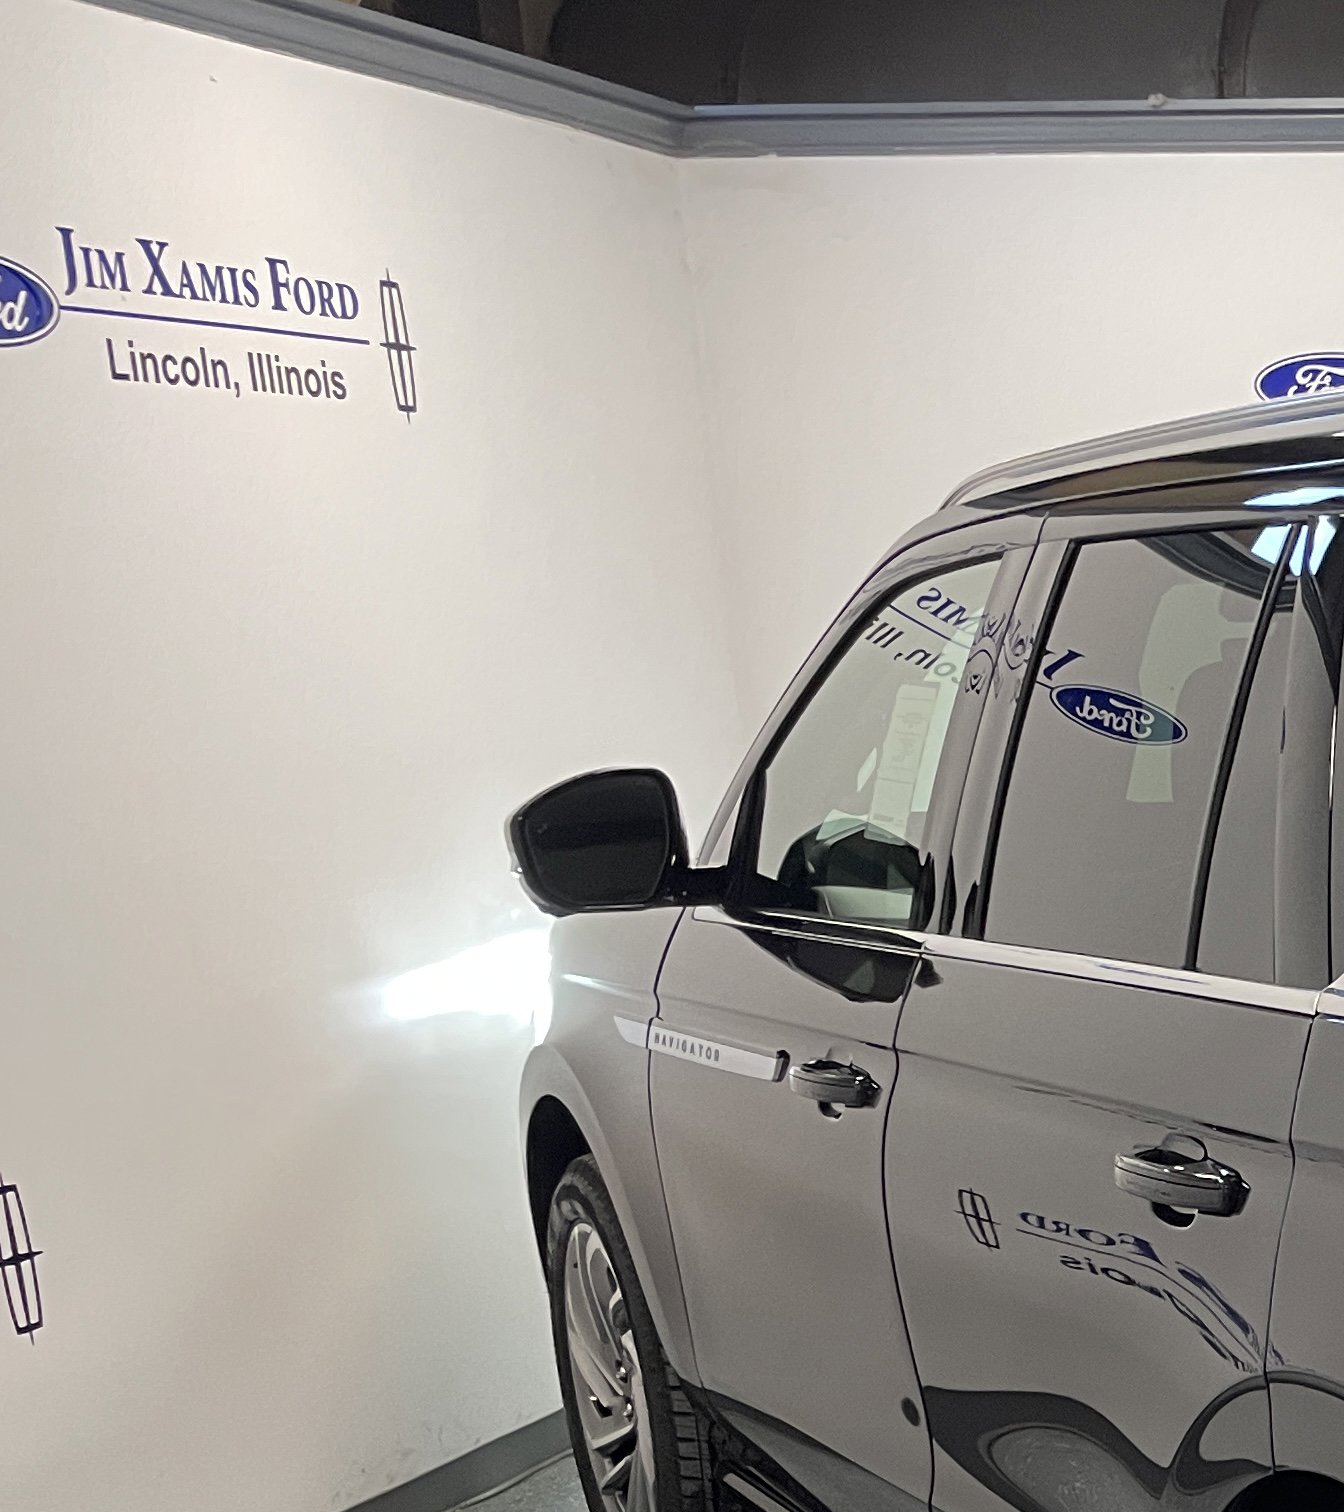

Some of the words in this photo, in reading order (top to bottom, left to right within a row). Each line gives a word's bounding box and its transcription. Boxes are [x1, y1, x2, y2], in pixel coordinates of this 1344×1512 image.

[55, 226, 131, 296] JIM
[135, 238, 260, 308] XAMIS
[264, 257, 359, 320] FORD
[106, 337, 241, 398] Lincoln,
[247, 352, 348, 400] Illinois
[654, 1032, 721, 1063] NAVIGATOR
